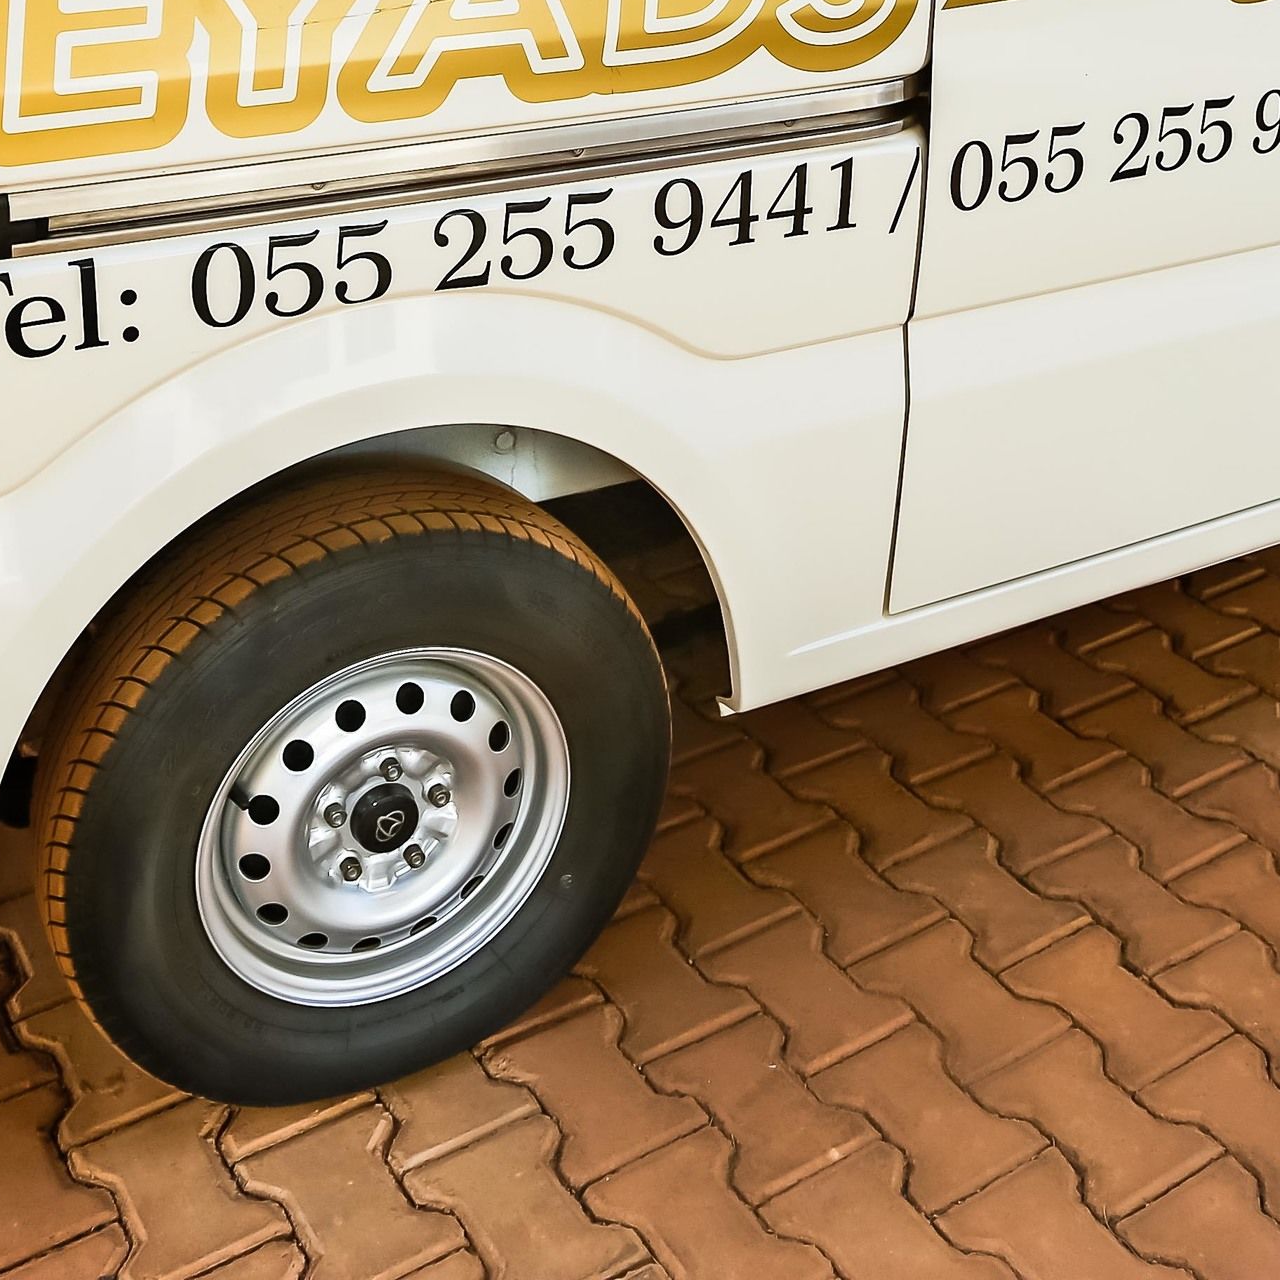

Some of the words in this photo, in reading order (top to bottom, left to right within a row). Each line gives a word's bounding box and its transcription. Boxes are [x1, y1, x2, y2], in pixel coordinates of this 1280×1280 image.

[191, 219, 392, 328] 055
[433, 187, 615, 292] 255
[653, 156, 857, 256] 9441
[889, 146, 920, 234] /
[950, 121, 1086, 212] 055
[1109, 95, 1235, 183] 255
